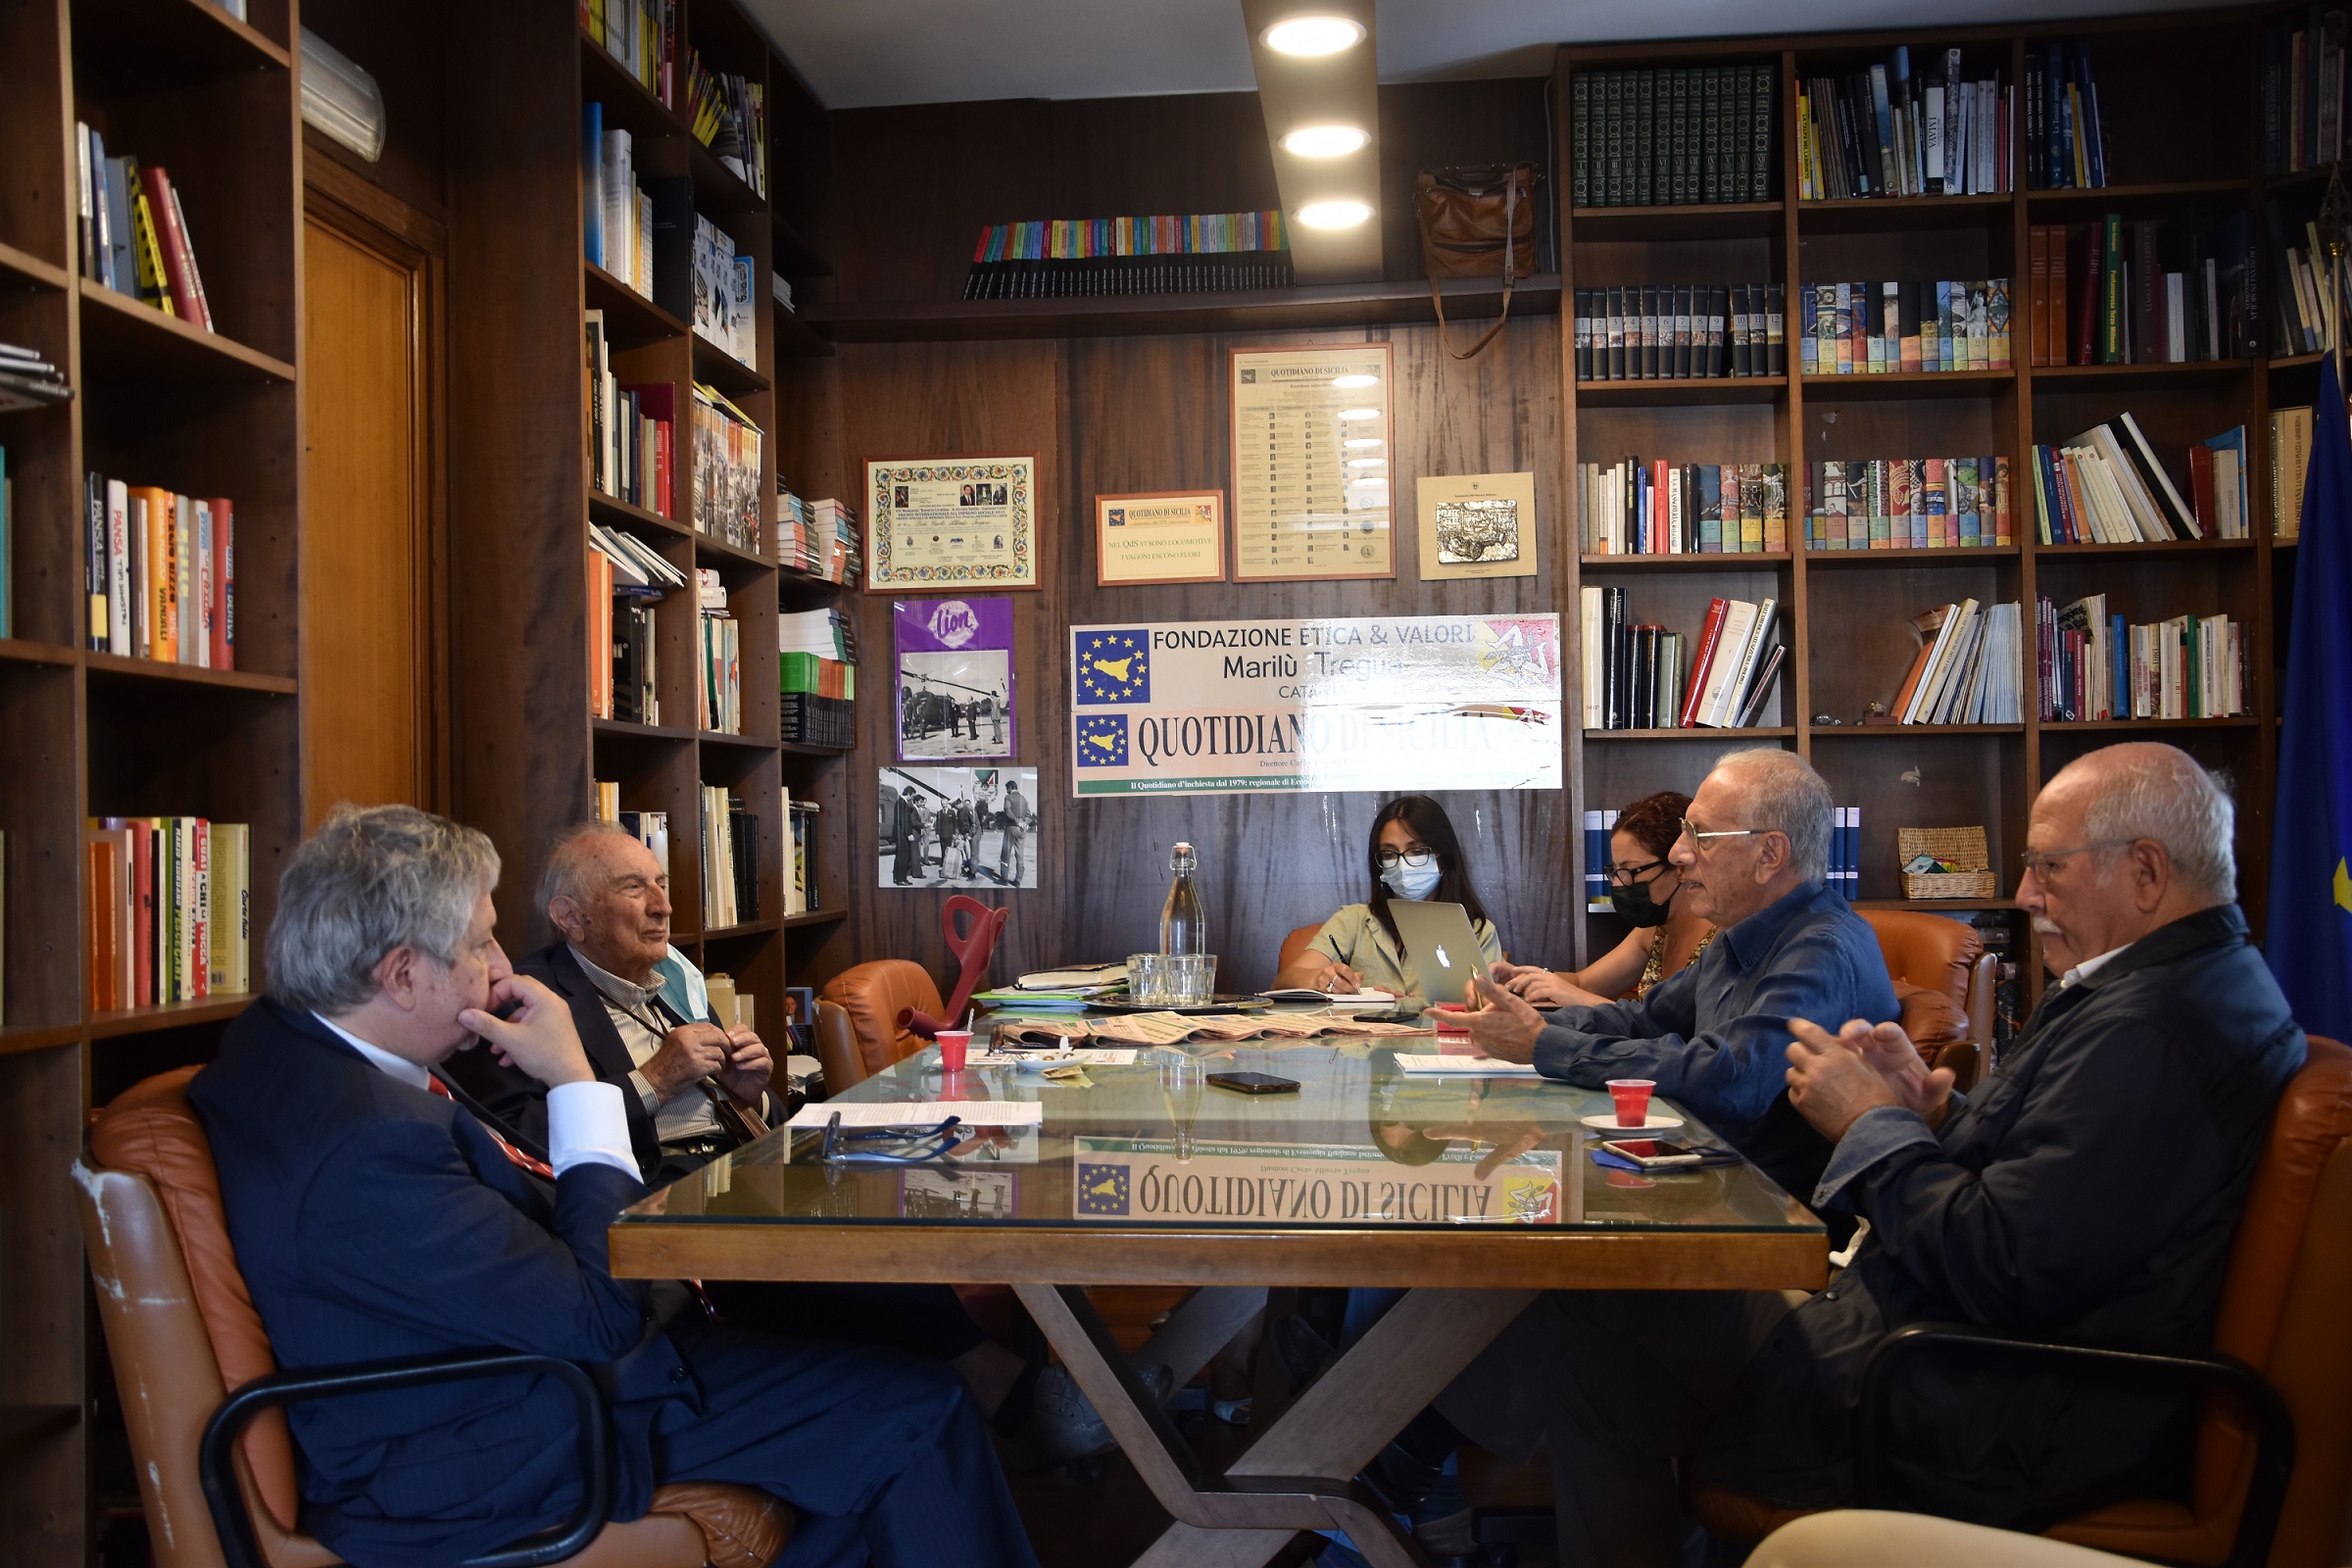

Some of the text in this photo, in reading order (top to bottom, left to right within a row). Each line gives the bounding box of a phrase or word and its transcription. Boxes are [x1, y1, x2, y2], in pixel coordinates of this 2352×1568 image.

[1928, 122, 1936, 149] MAYA
[1270, 368, 1314, 377] QUOTIDIANO
[93, 500, 104, 551] PANSA
[1129, 509, 1163, 520] QUOTIDIANO
[1170, 508, 1191, 516] SICILIA
[114, 510, 122, 556] PANSA
[1122, 539, 1139, 549] QdS
[1167, 538, 1212, 547] LOCOMOTIVE
[1153, 622, 1474, 650] FONDAZIONE ETICA & VALORI
[1224, 651, 1402, 682] Marilù Tregua
[1138, 712, 1326, 767] QUOTIDIANO
[1259, 760, 1289, 768] Direttore
[1130, 776, 1290, 791] Il Quotidiano d'inchiesta dal 1979: regionale di
[173, 909, 182, 981] PESCECANI
